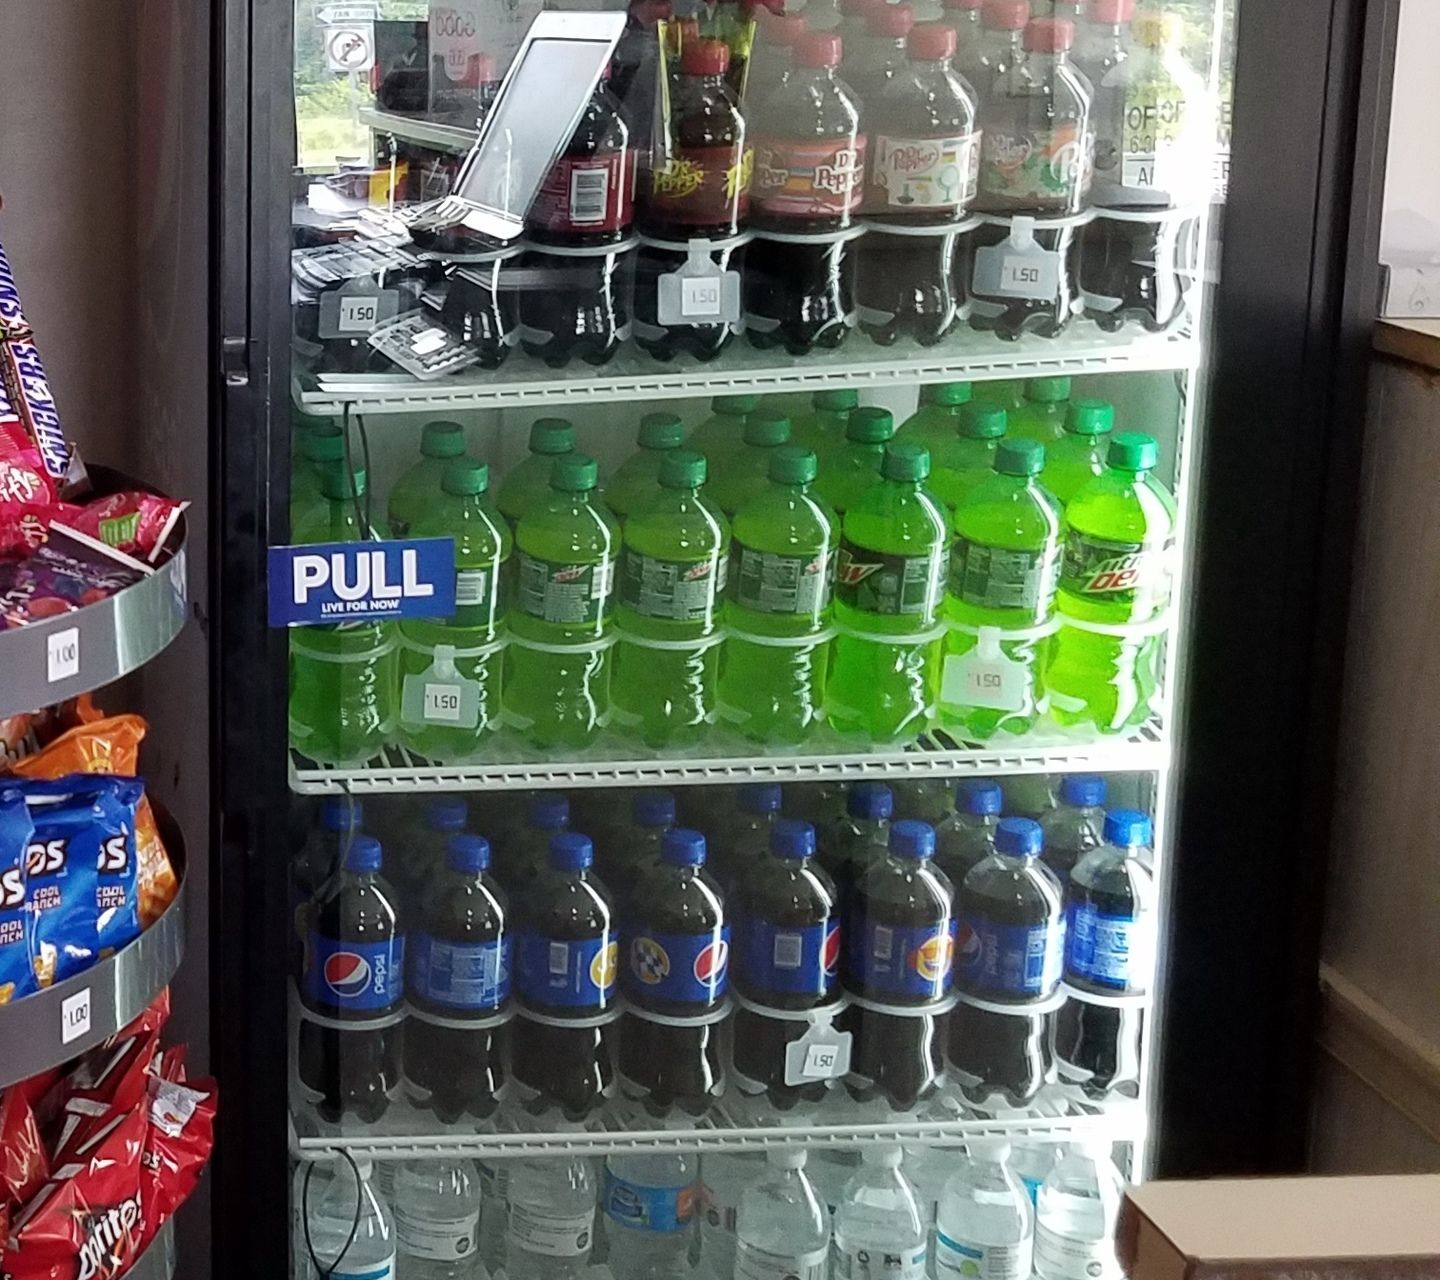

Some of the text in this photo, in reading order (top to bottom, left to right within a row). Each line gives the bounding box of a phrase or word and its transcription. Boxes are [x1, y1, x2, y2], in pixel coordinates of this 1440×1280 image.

[10, 343, 70, 478] SNICKERS
[292, 549, 435, 605] PULL
[321, 599, 401, 614] LIVE FOR NOW
[374, 953, 387, 995] pepsi
